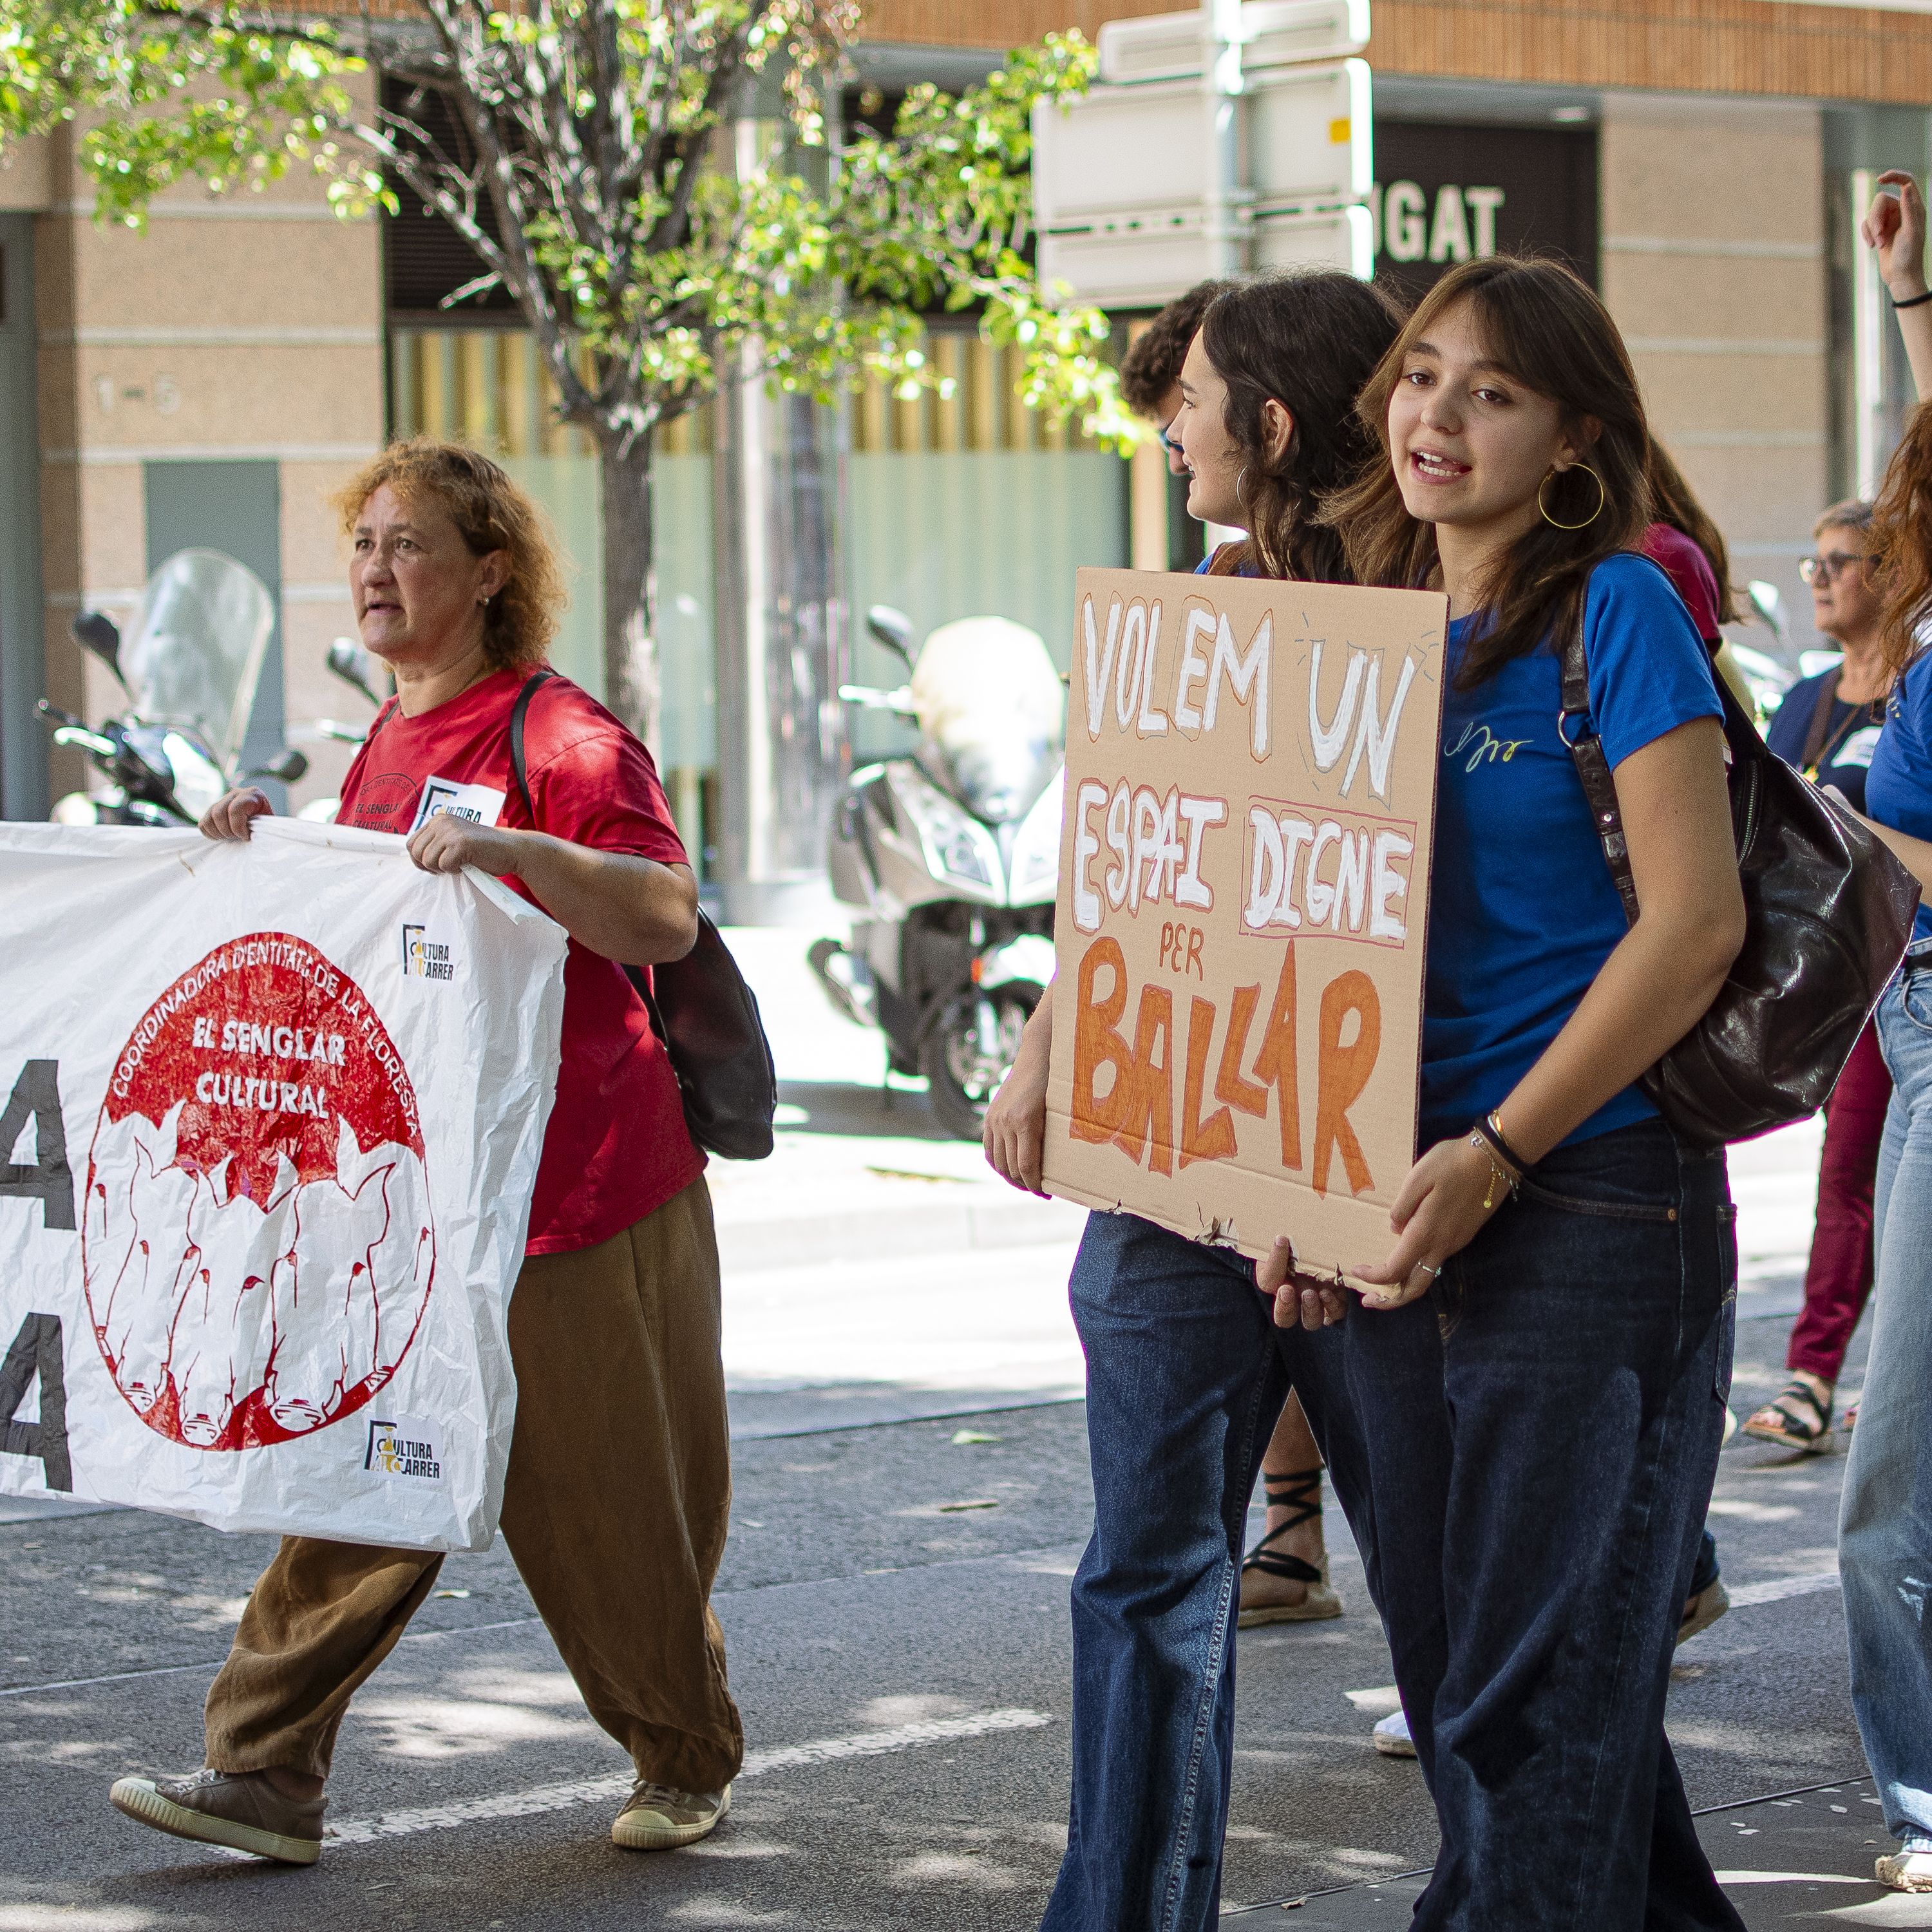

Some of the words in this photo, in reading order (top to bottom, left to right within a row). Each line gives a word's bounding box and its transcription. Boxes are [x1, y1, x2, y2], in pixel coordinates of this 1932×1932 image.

[1373, 180, 1506, 264] GAT
[1081, 591, 1274, 763] VOLEM
[1309, 638, 1426, 810] UN
[355, 803, 365, 814] EL
[365, 803, 403, 815] SENGLA
[1072, 776, 1229, 936] ESPAI
[1243, 805, 1414, 939] DIGNE
[1159, 921, 1204, 981] PER
[112, 953, 227, 1098] COORDINADORA
[314, 963, 340, 999] DE
[341, 987, 361, 1021] LA
[361, 1015, 419, 1138] FLORESTA
[192, 1016, 216, 1050] EL
[220, 1019, 346, 1066] SENGLAR
[1069, 936, 1382, 1200] BALLAR
[196, 1071, 330, 1119] CULTURAL
[376, 1437, 433, 1461] CULTURA
